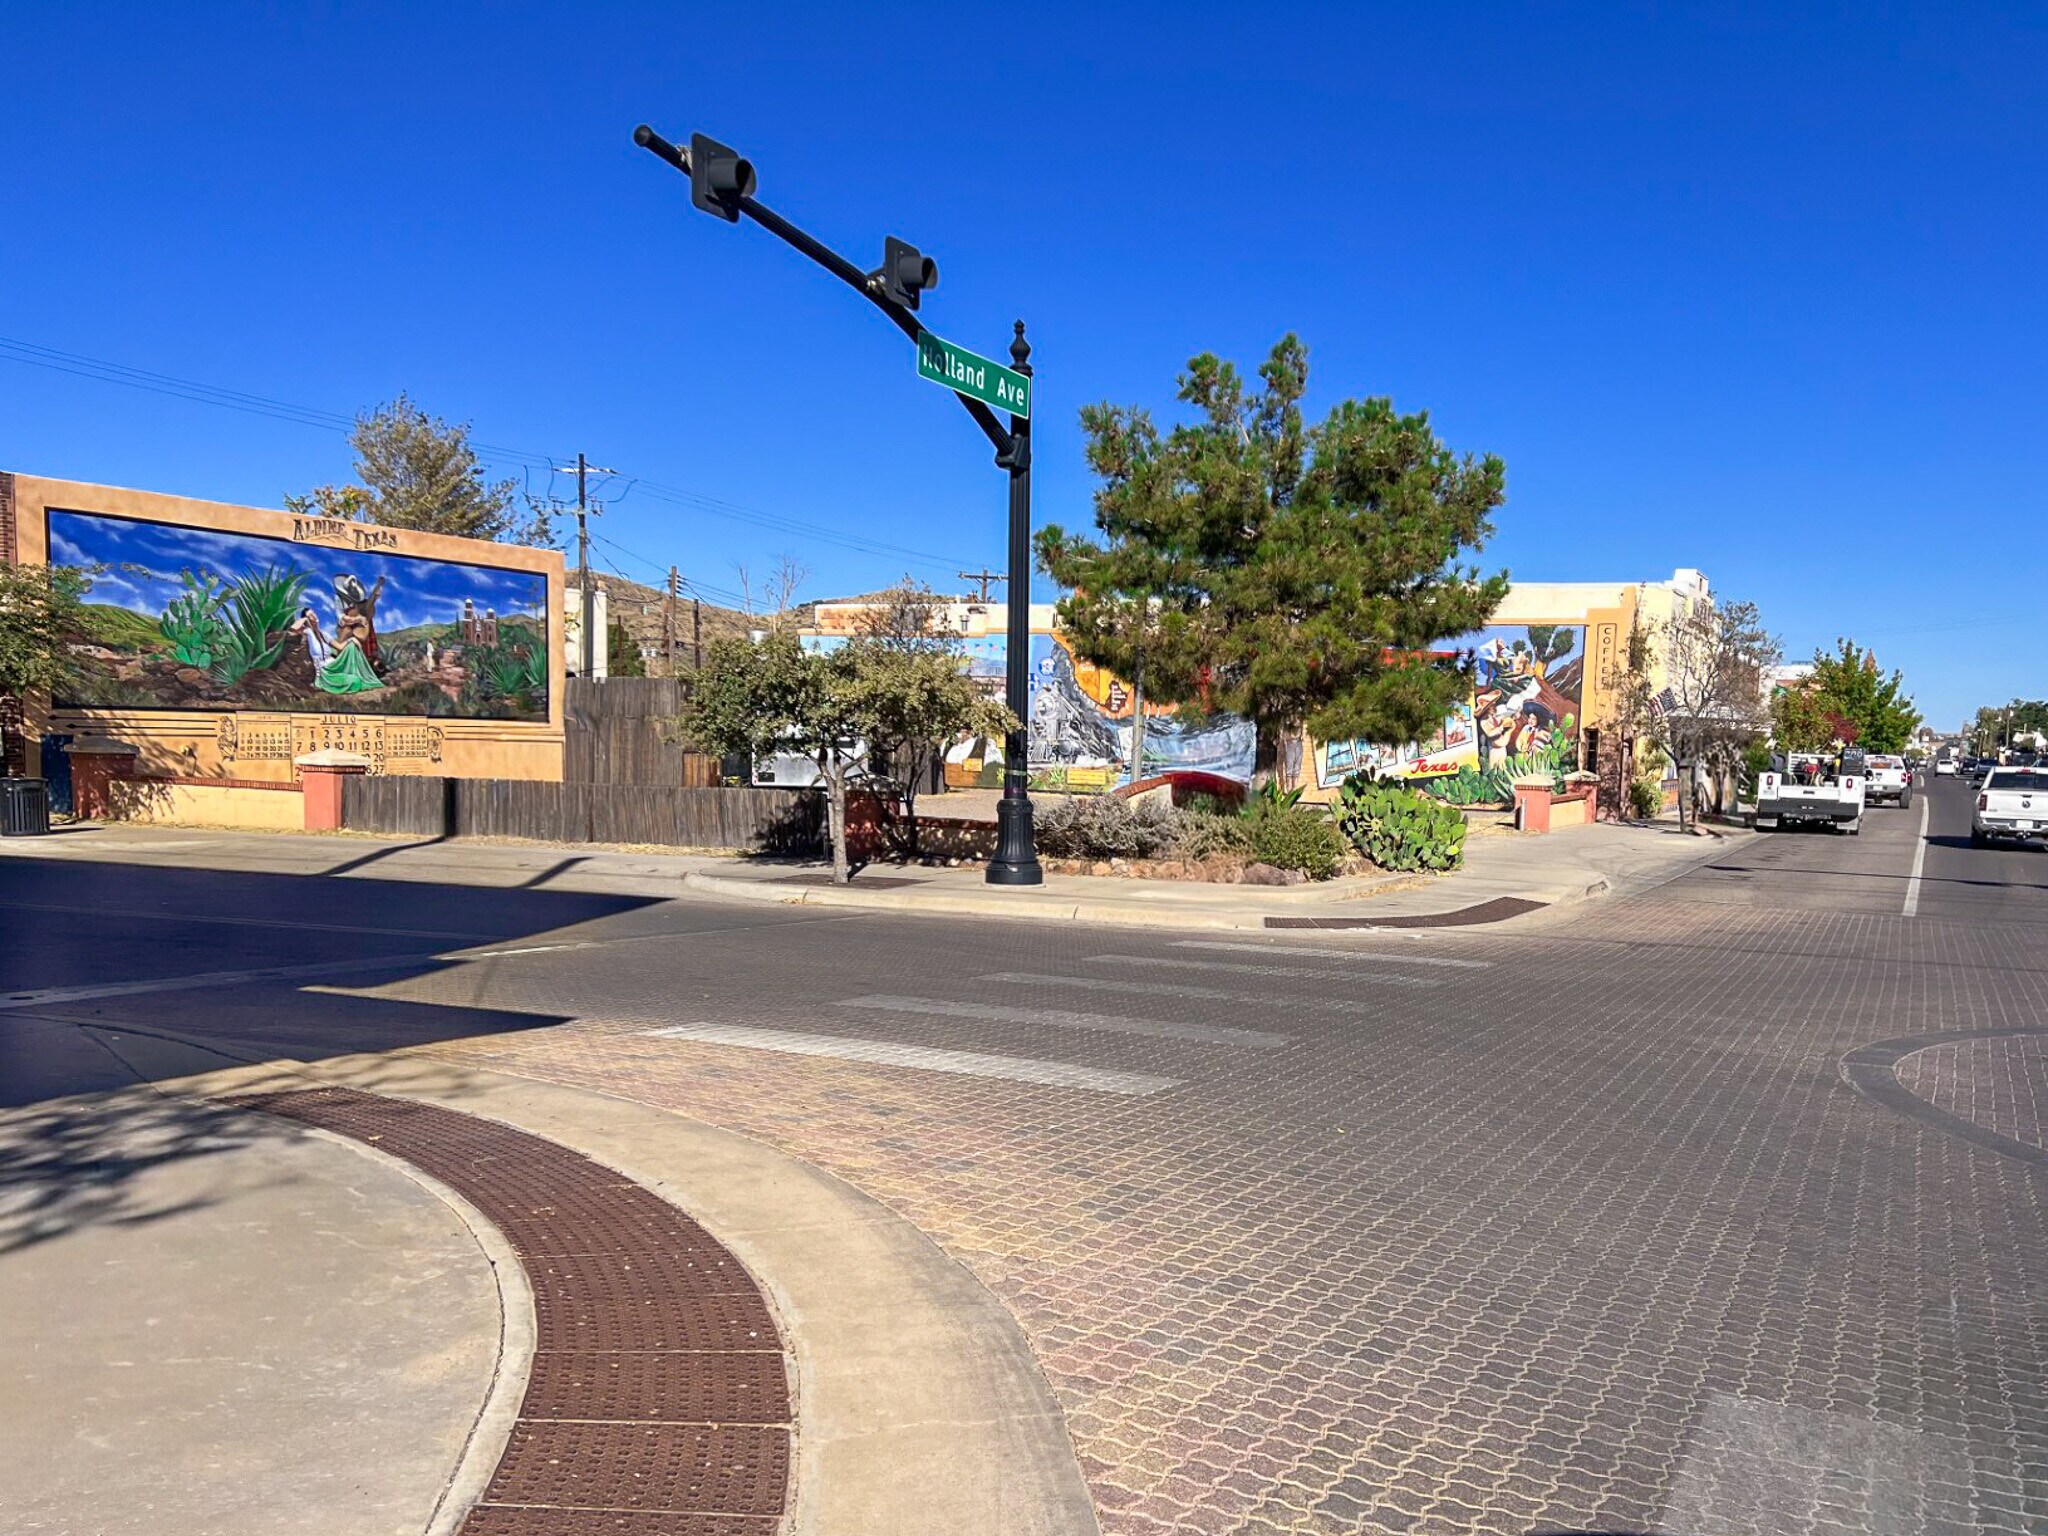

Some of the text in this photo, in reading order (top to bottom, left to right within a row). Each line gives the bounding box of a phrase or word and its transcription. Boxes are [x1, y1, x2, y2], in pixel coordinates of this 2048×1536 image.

[923, 345, 1024, 406] Holland Ave
[353, 529, 398, 549] TEXAS
[322, 715, 356, 724] JULIO
[323, 729, 330, 739] 2
[336, 729, 342, 739] 3
[349, 729, 356, 738] 4
[362, 729, 369, 738] 5
[376, 728, 383, 738] 6
[296, 742, 302, 752] 7
[309, 742, 316, 752] 8
[334, 741, 344, 750] 10
[348, 741, 357, 751] 11
[361, 741, 370, 751] 12
[374, 740, 384, 750] 13
[373, 753, 384, 763] 20
[1408, 758, 1458, 774] Texas
